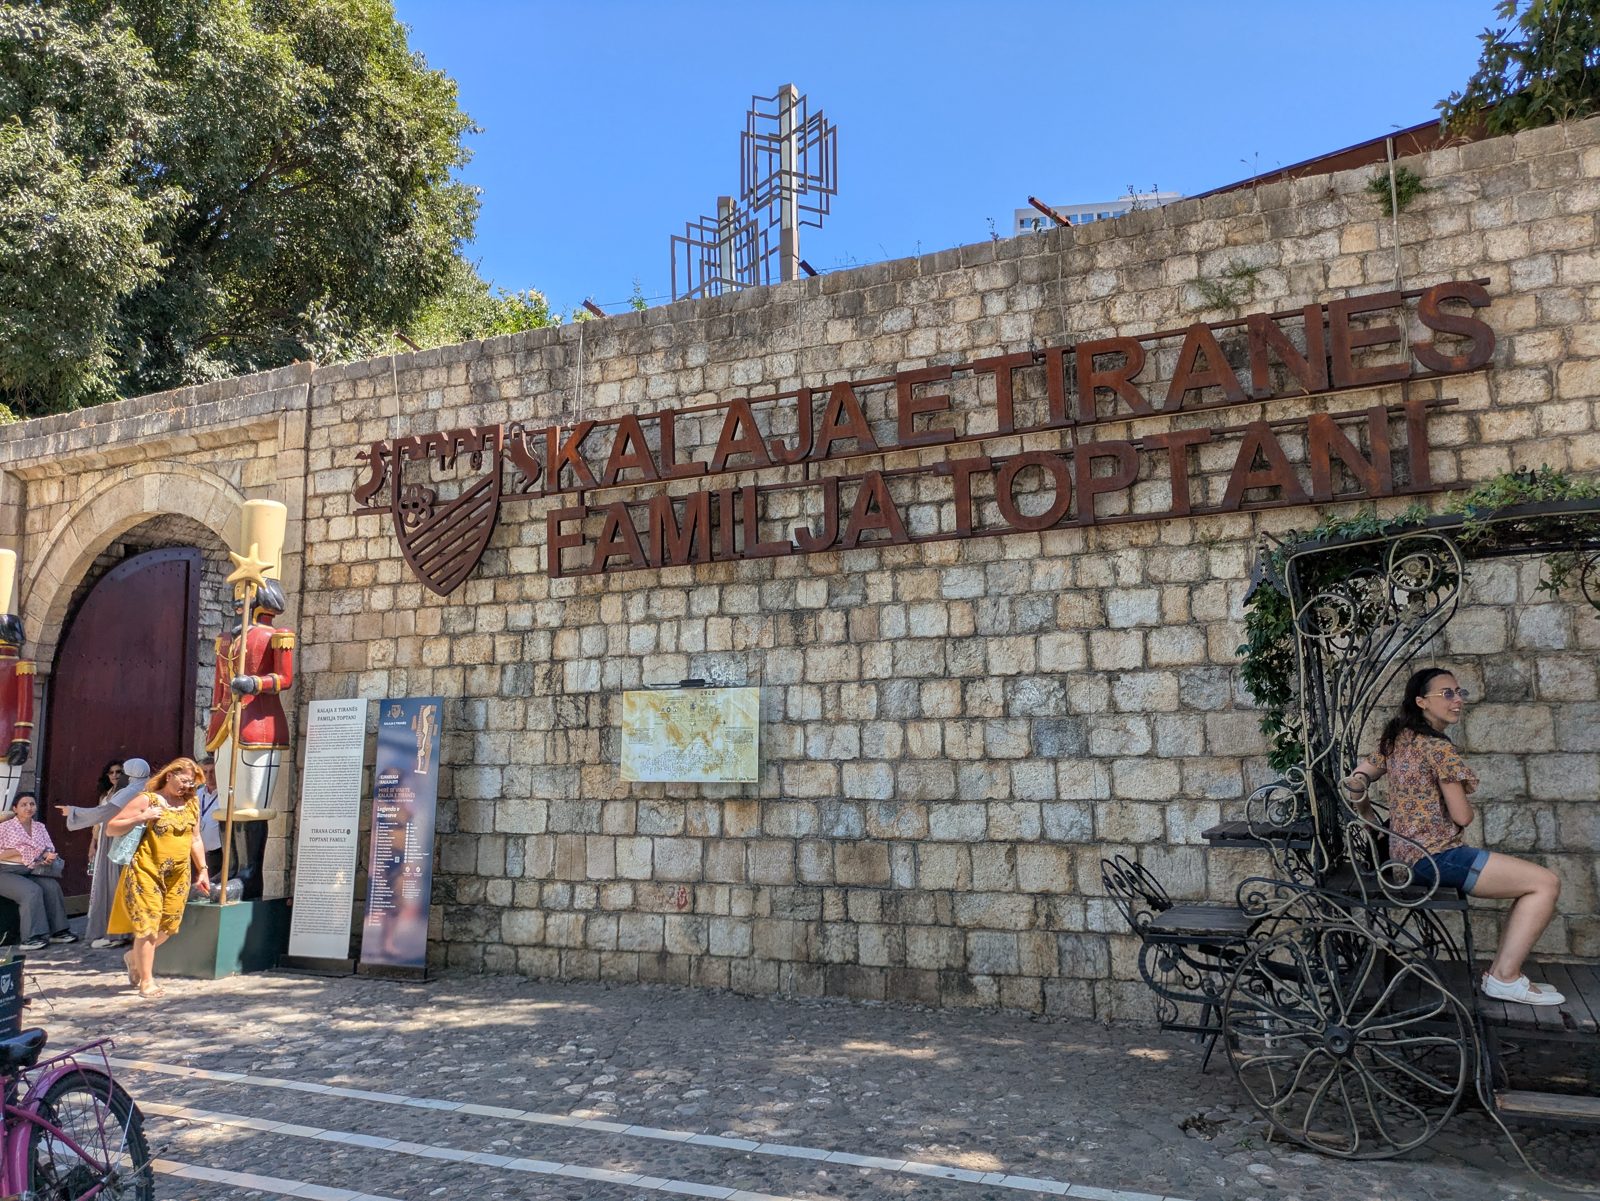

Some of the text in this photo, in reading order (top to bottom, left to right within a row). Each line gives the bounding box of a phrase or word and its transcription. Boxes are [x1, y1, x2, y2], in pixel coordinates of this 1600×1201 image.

[546, 280, 1496, 492] KALAJA E TIRANES
[547, 399, 1438, 578] FAMILJA TOPTANI
